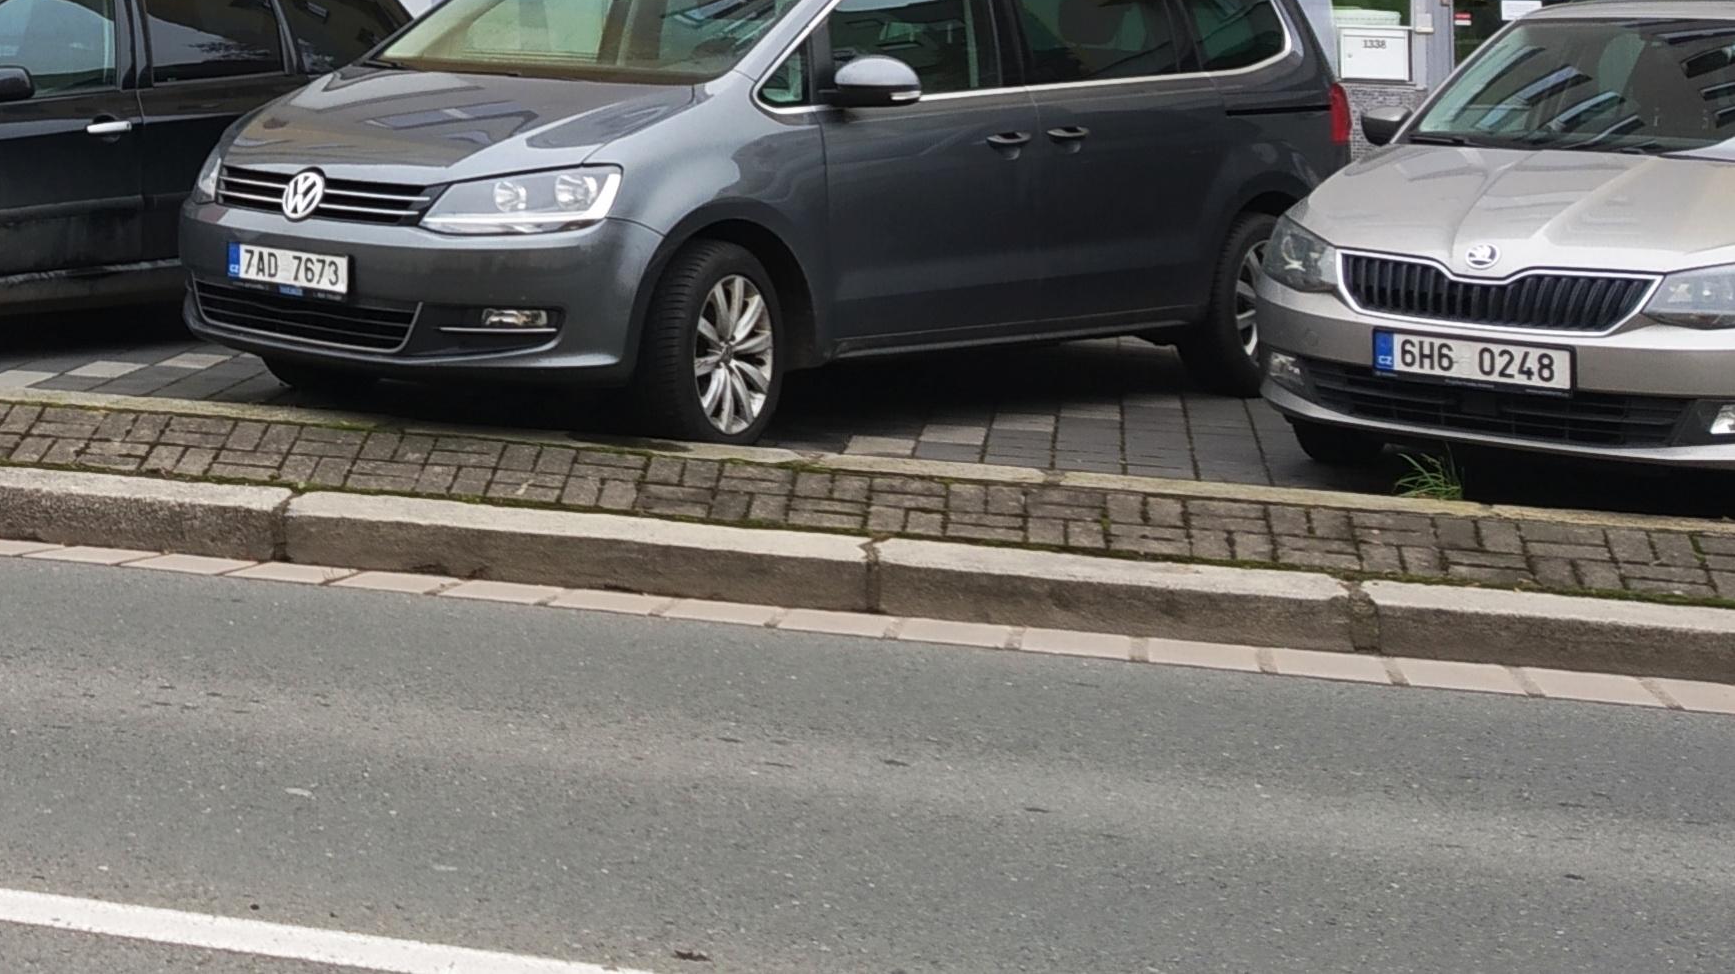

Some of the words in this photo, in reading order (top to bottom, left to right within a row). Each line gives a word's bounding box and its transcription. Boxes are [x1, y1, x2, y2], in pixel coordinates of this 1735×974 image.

[245, 249, 278, 278] 7AD
[292, 255, 340, 286] 7673
[1378, 355, 1393, 366] CZ
[1401, 339, 1454, 371] 6H6
[1478, 347, 1555, 382] 0248
